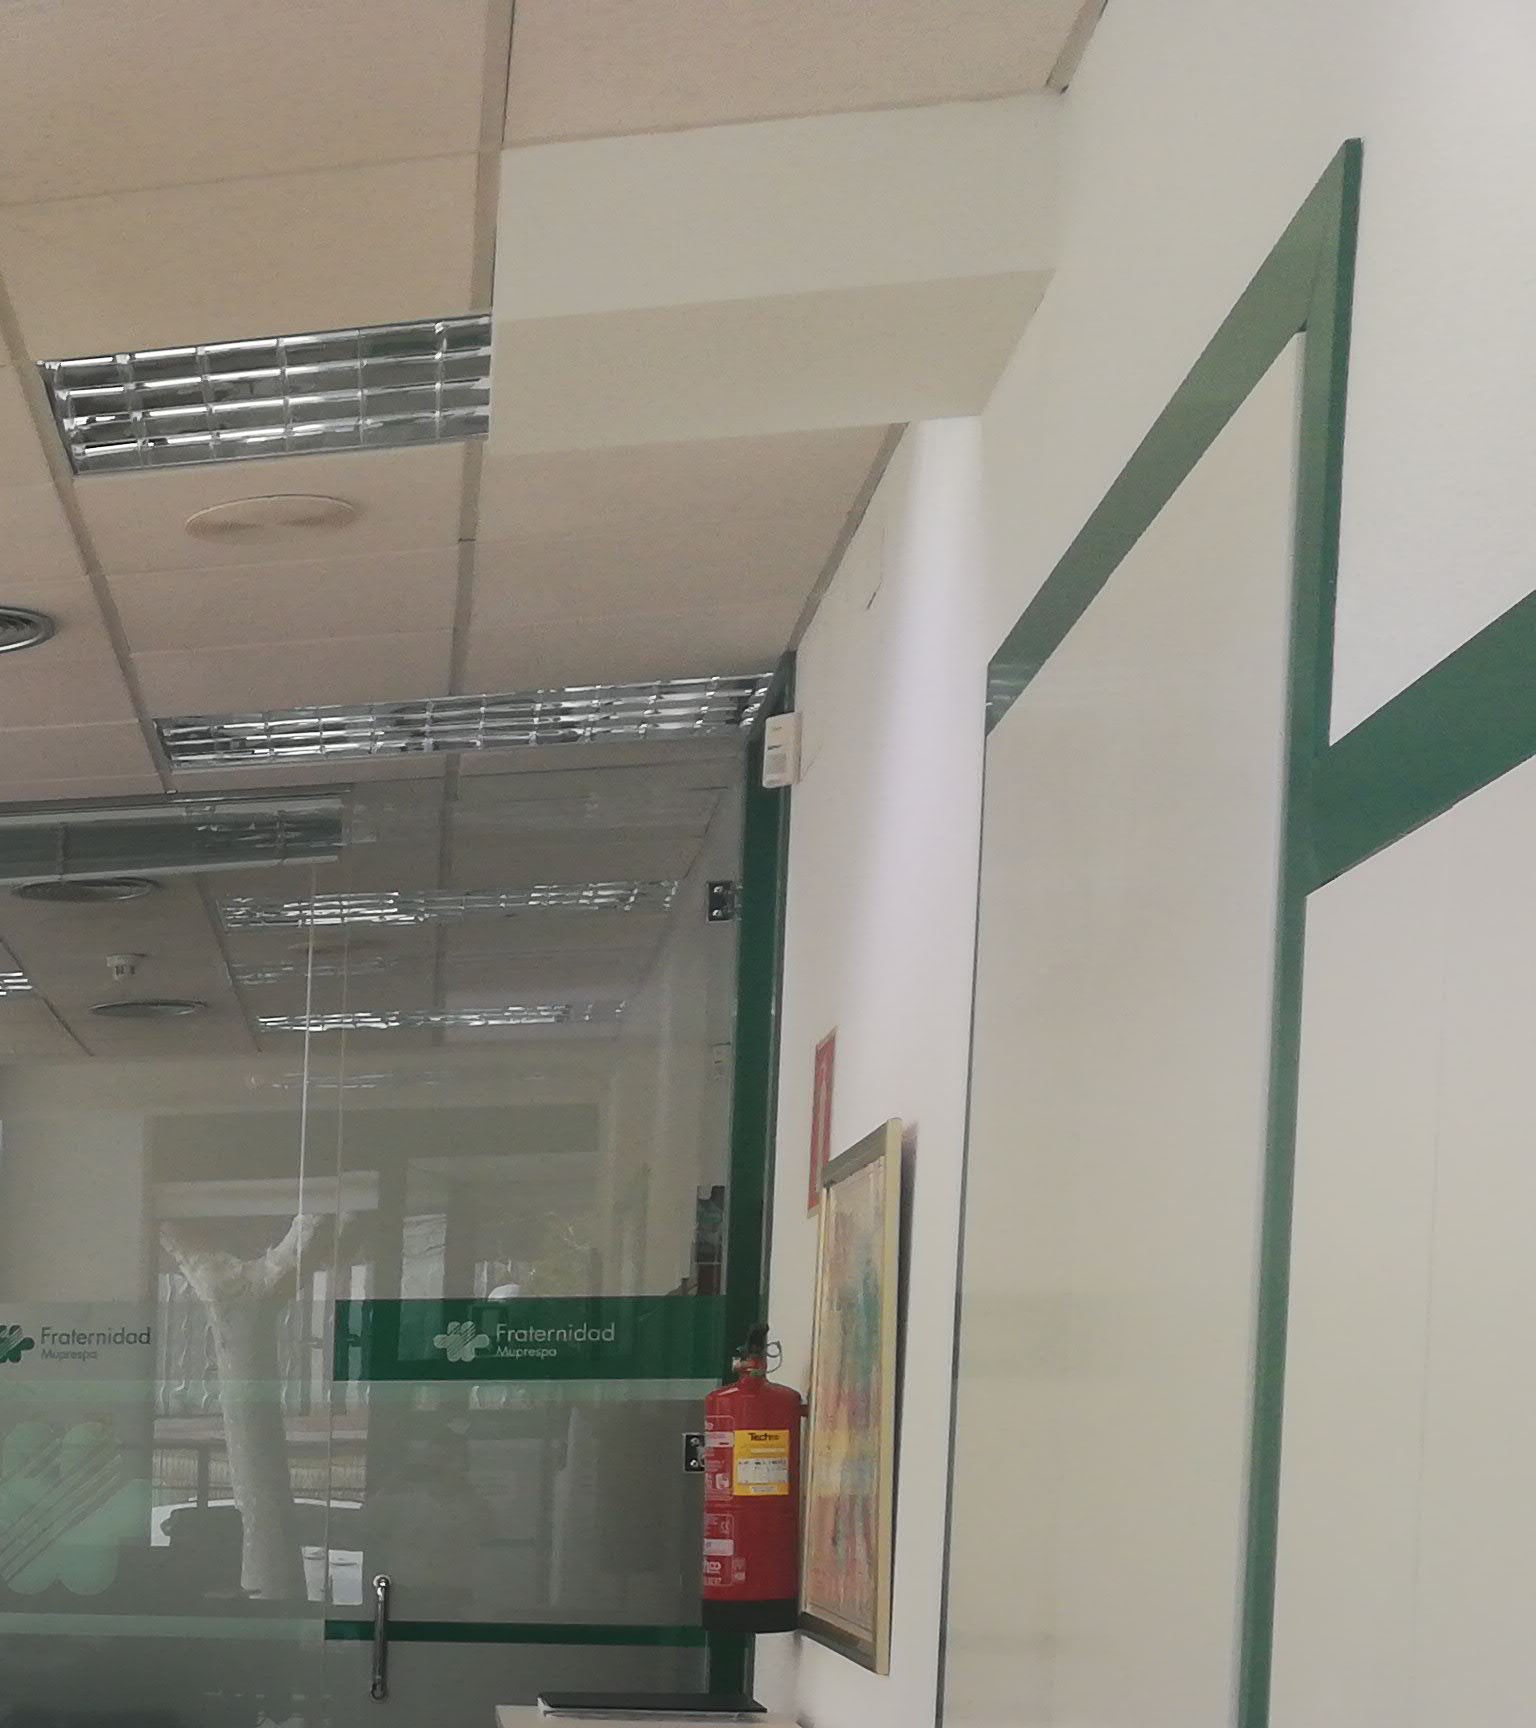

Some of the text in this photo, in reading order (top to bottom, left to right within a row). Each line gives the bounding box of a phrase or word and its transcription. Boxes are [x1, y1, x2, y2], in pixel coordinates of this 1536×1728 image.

[40, 1327, 151, 1346] Fraternidad
[496, 1322, 616, 1343] Fraternidad
[40, 1348, 99, 1363] Muprespa
[496, 1345, 558, 1360] Muprespa
